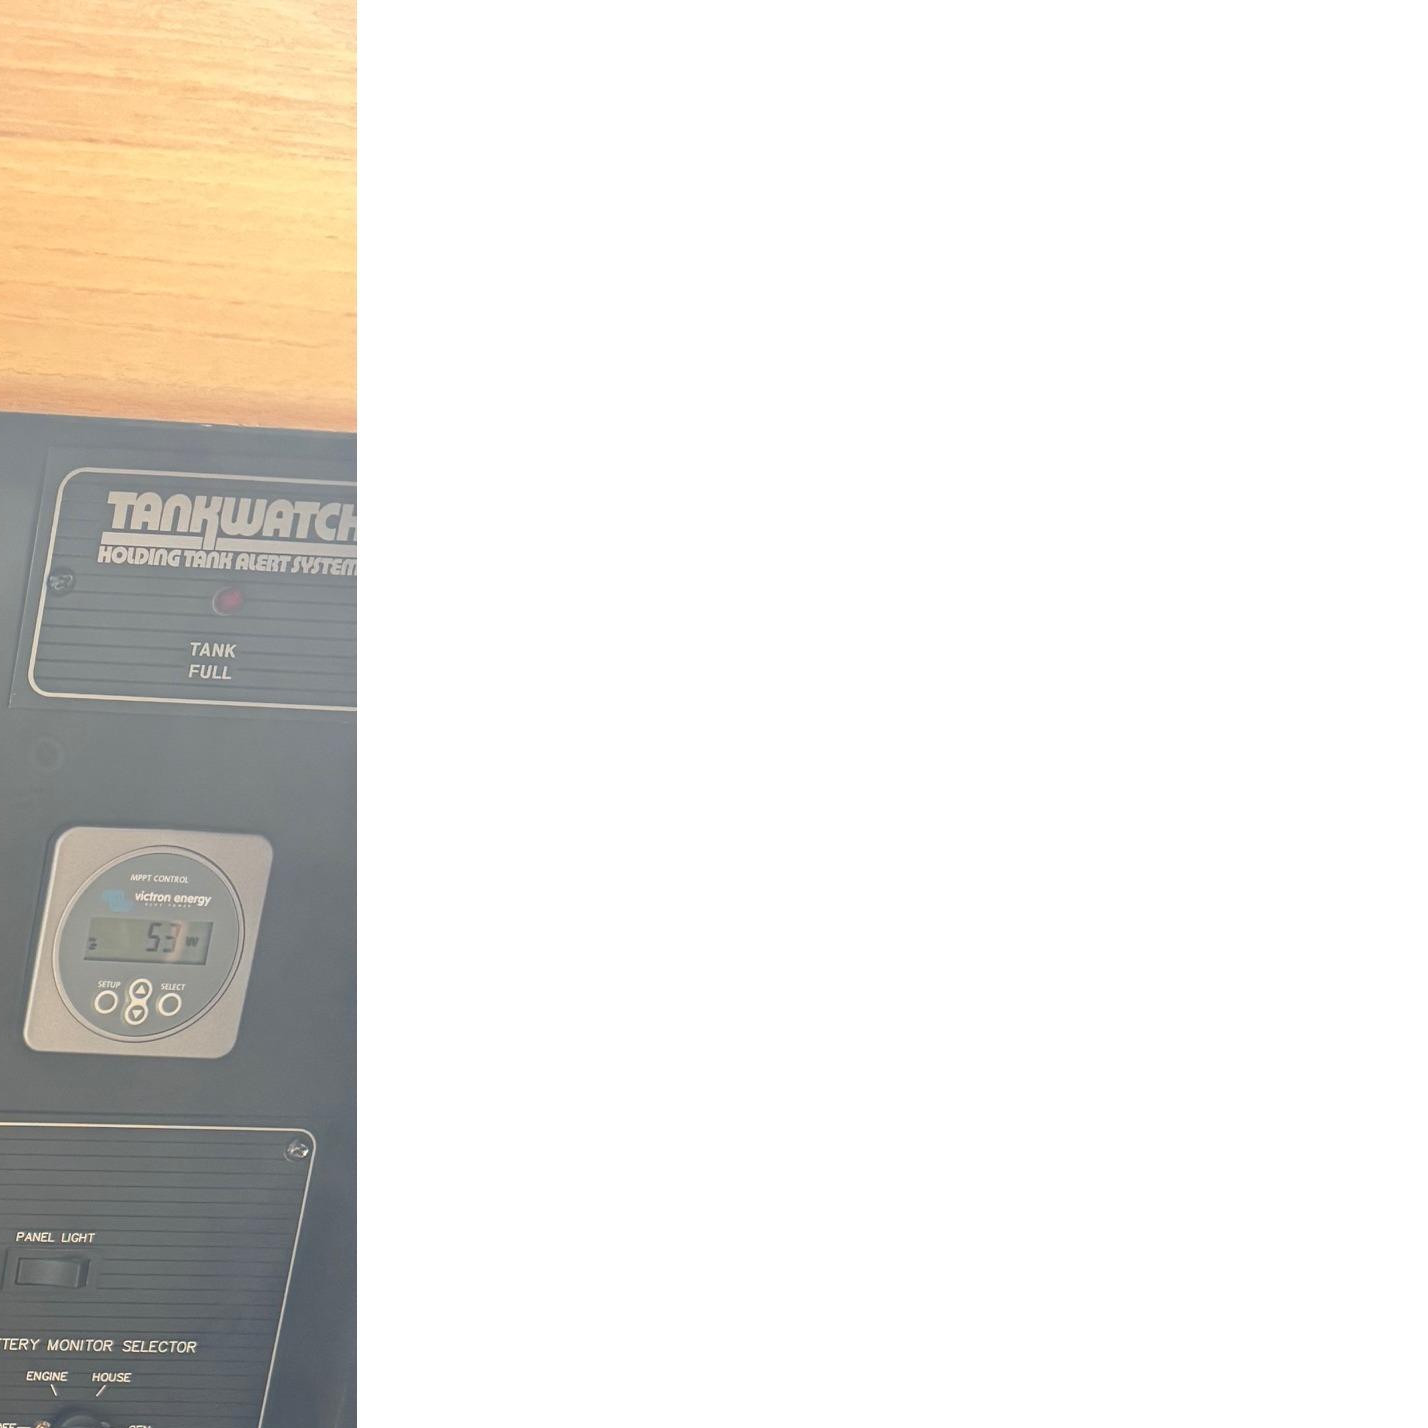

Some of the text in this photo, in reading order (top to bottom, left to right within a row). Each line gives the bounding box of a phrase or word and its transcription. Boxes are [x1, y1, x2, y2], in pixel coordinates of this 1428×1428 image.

[97, 546, 181, 567] HOLDING
[184, 549, 233, 570] TANK
[235, 552, 291, 573] ALERT
[190, 642, 237, 658] TANK
[188, 664, 231, 680] FULL
[47, 1339, 113, 1352] MONITOR
[122, 1341, 197, 1353] SELECTOR
[26, 1371, 68, 1382] ENGINE
[92, 1372, 132, 1383] HOUSE
